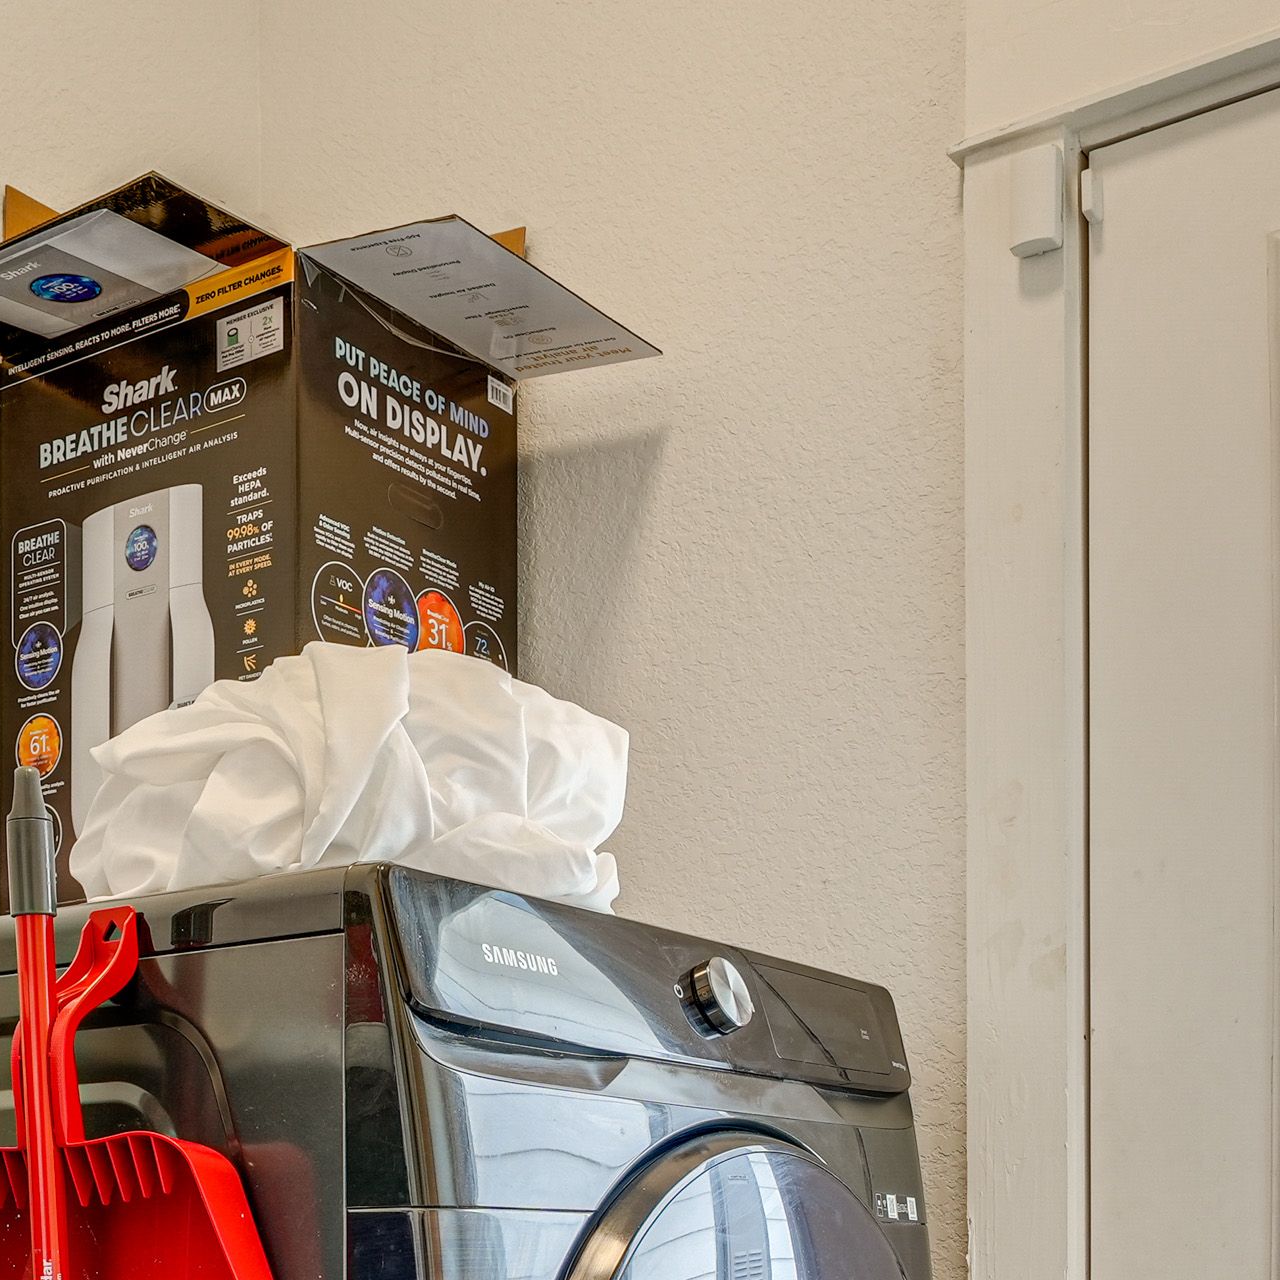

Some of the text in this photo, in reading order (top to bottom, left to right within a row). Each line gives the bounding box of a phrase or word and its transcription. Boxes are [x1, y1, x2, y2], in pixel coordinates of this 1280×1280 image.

[0, 260, 41, 282] Shark
[195, 265, 283, 305] ZERO FILTER CHANGES.
[226, 304, 274, 326] MEMBER EXCLUSIVE
[101, 366, 177, 415] Shark
[210, 384, 241, 407] MAX
[335, 336, 490, 439] PUT PEACE OF MIND
[337, 371, 488, 477] ON DISPLAY.
[48, 431, 238, 498] PROACTIVE PURIFICATION & INTELLIGENT AIR ANALYSIS
[93, 453, 115, 470] with
[233, 466, 267, 485] Exceeds
[230, 488, 270, 507] standard.
[238, 480, 261, 494] HEPA
[236, 509, 263, 525] TRAPS
[18, 530, 60, 554] BREATHE
[226, 520, 273, 542] 99.98% OF
[23, 547, 55, 567] CLEAR
[336, 577, 353, 592] VOC
[481, 943, 559, 976] SAMSUNG
